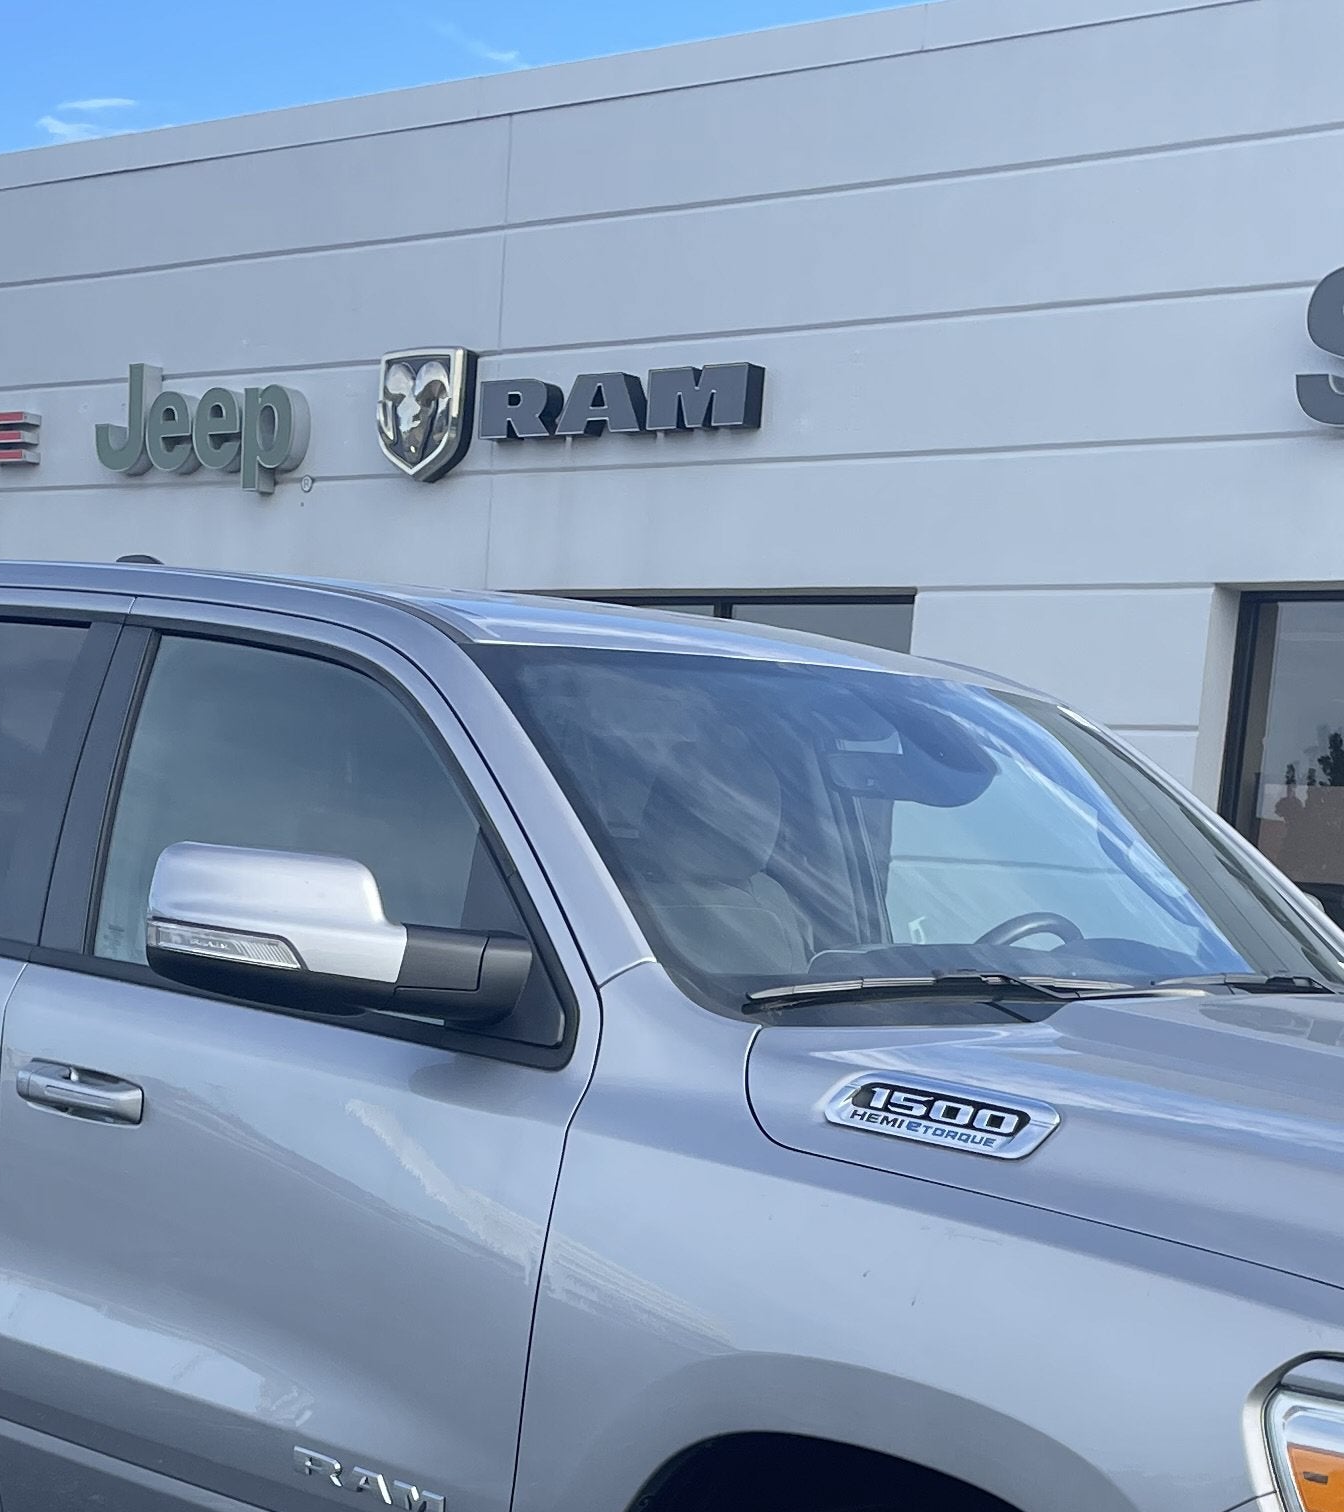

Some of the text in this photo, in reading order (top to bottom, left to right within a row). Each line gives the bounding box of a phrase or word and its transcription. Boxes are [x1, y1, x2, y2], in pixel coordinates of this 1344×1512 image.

[96, 363, 311, 493] Jeep
[479, 361, 765, 440] RAM
[849, 1108, 905, 1130] HEMI
[870, 1086, 1019, 1134] 1500
